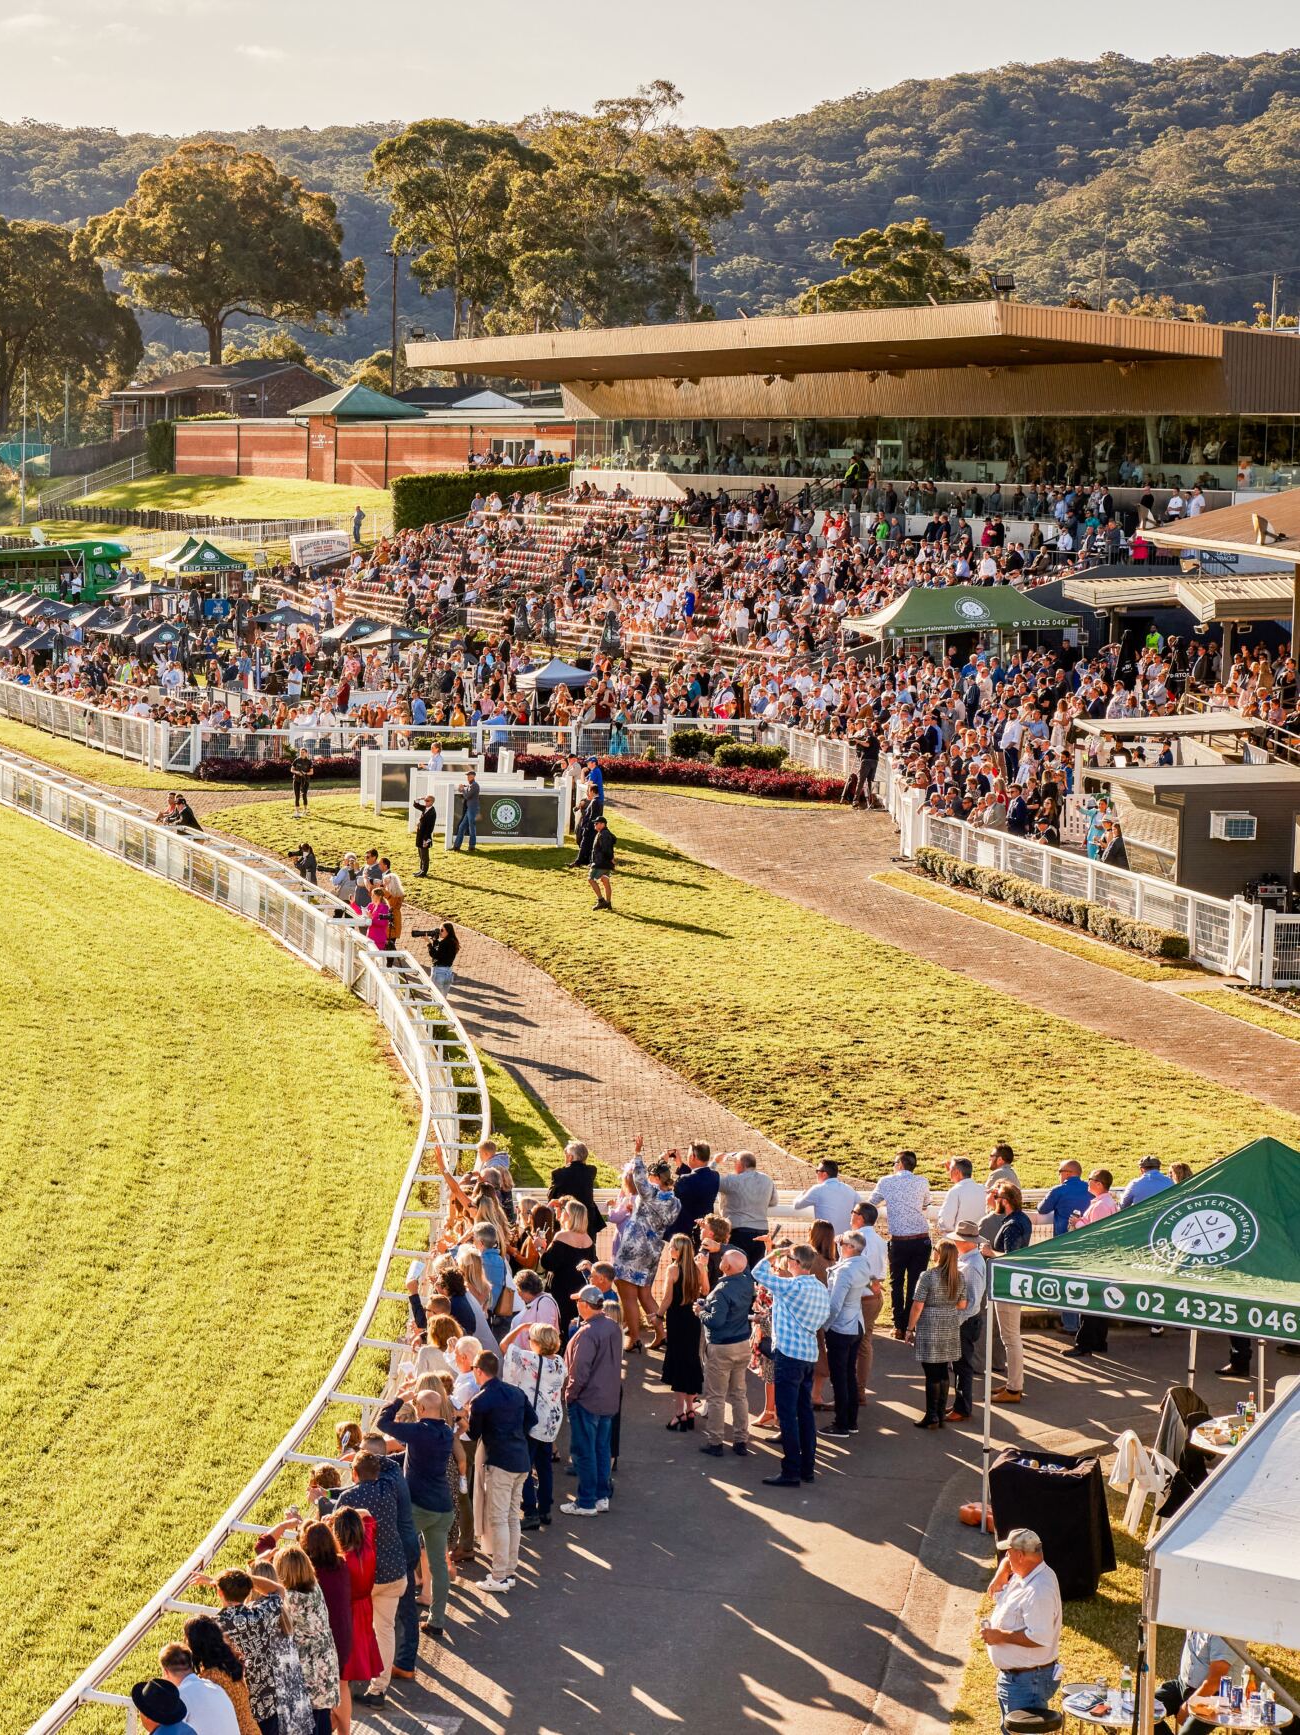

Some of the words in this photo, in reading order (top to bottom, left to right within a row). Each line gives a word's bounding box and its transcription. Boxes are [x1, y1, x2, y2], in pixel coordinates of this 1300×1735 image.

[44, 583, 58, 593] HERE
[1163, 1210, 1182, 1226] THE
[1187, 1199, 1251, 1245] ENTERTAINMENT
[1131, 1262, 1175, 1275] CENTRAL
[1178, 1270, 1217, 1282] COAST
[1136, 1291, 1165, 1314] 02
[1175, 1297, 1238, 1325] 4325
[1248, 1307, 1300, 1333] 046
